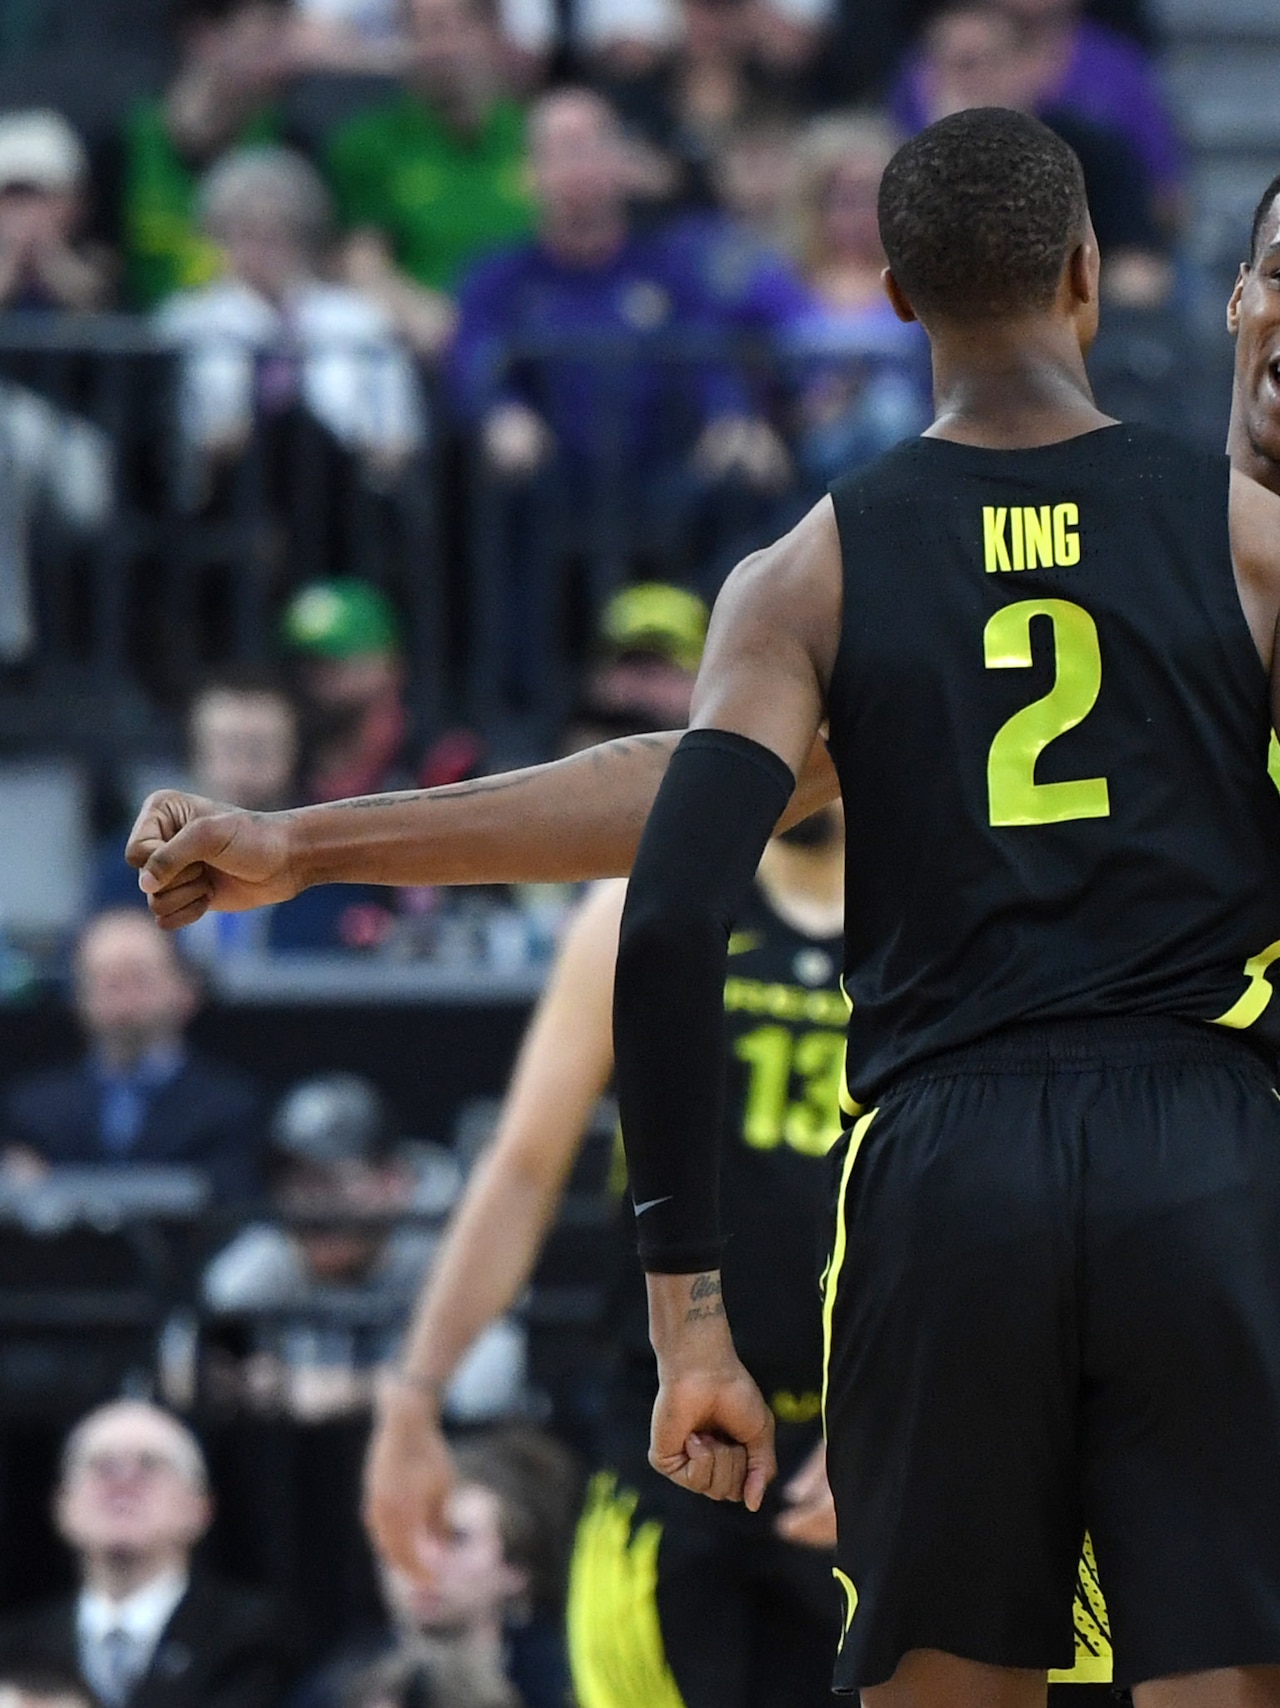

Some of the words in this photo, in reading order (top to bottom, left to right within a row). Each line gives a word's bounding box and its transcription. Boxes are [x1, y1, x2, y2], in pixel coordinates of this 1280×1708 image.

[982, 502, 1081, 573] KING
[983, 598, 1110, 827] 2
[733, 1025, 848, 1156] 13
